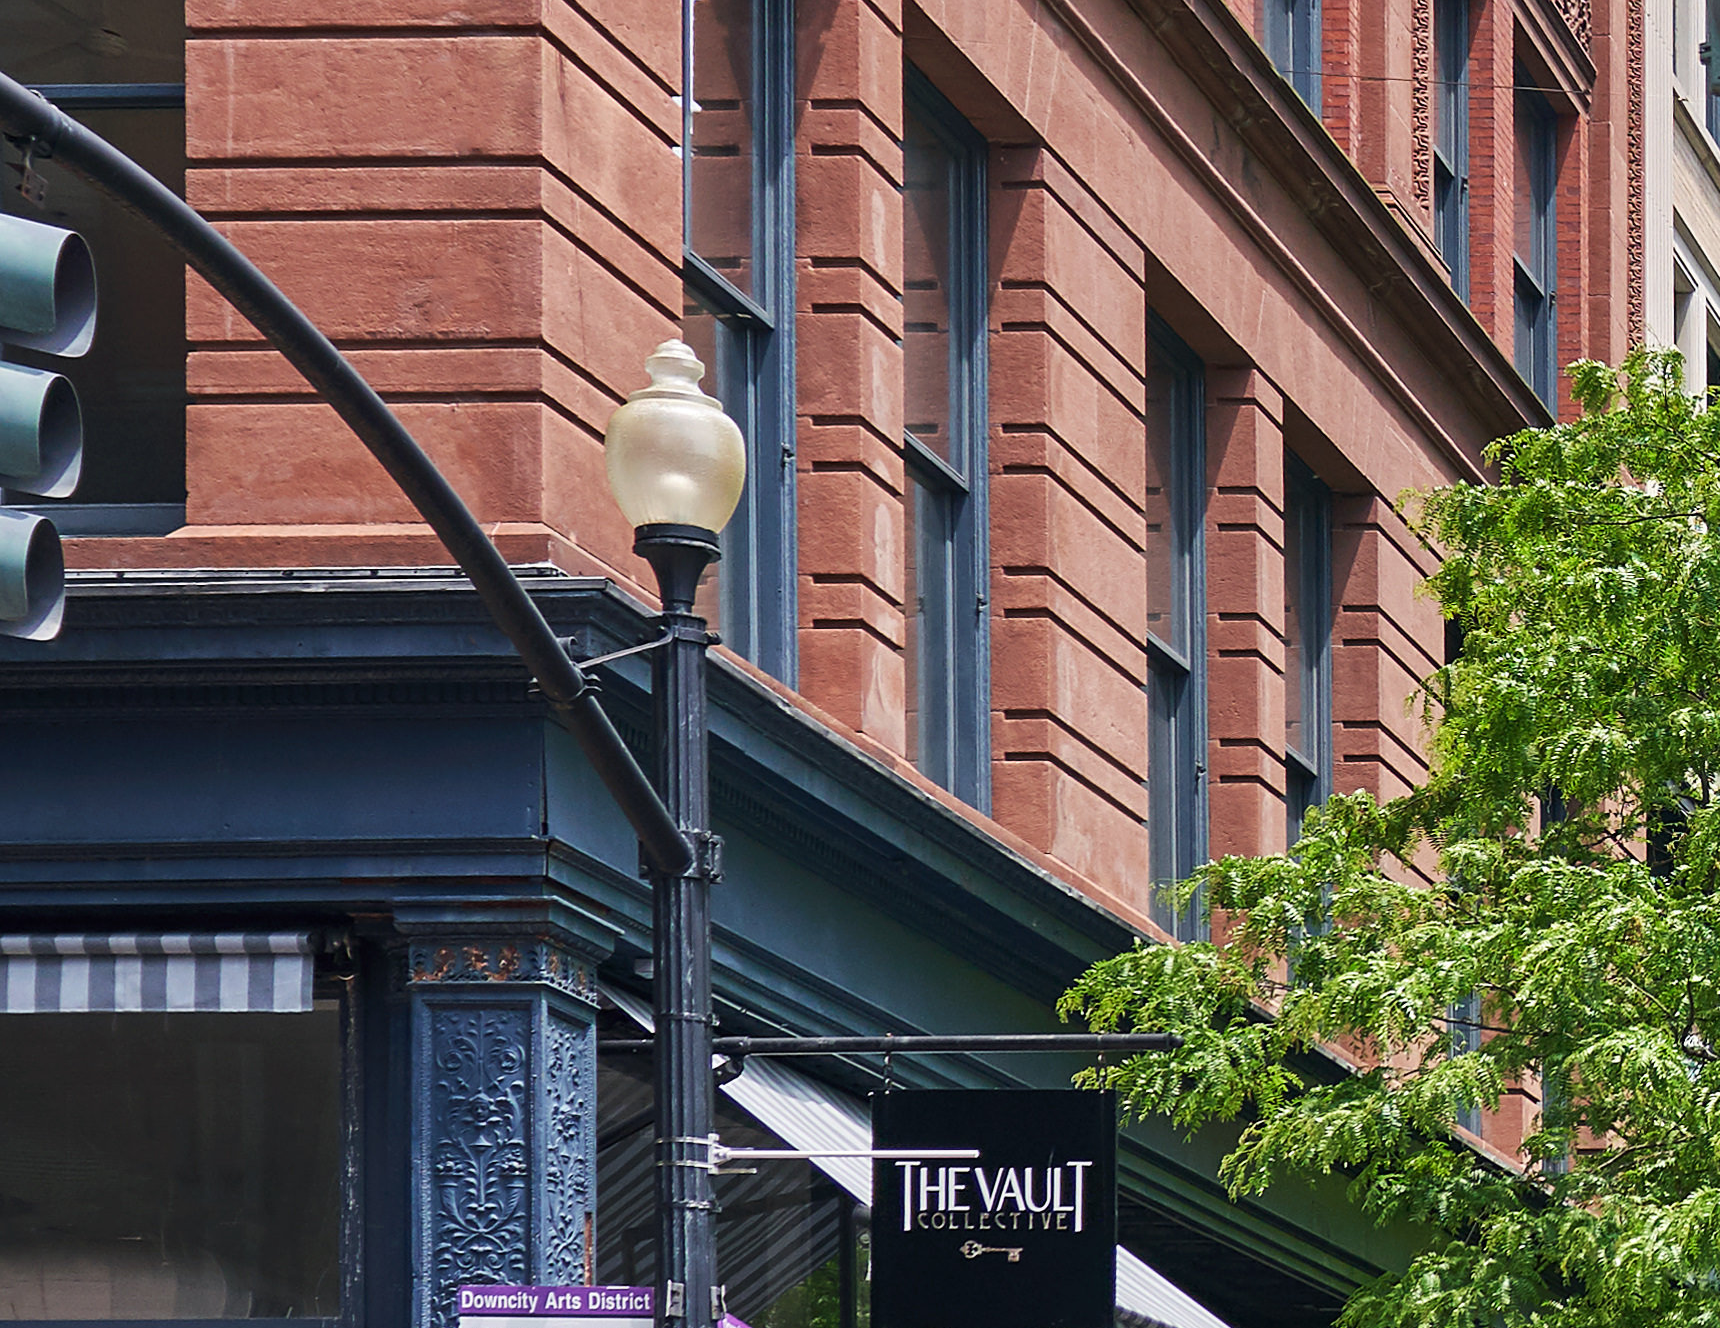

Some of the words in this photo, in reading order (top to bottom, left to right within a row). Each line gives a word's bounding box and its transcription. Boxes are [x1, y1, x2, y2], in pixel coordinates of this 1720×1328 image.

[894, 1160, 971, 1232] THE
[974, 1160, 1093, 1233] VAULT
[917, 1212, 1068, 1230] COLLECTIVE
[461, 1290, 538, 1313] Downcity
[545, 1292, 582, 1310] Arts
[589, 1292, 650, 1310] District
